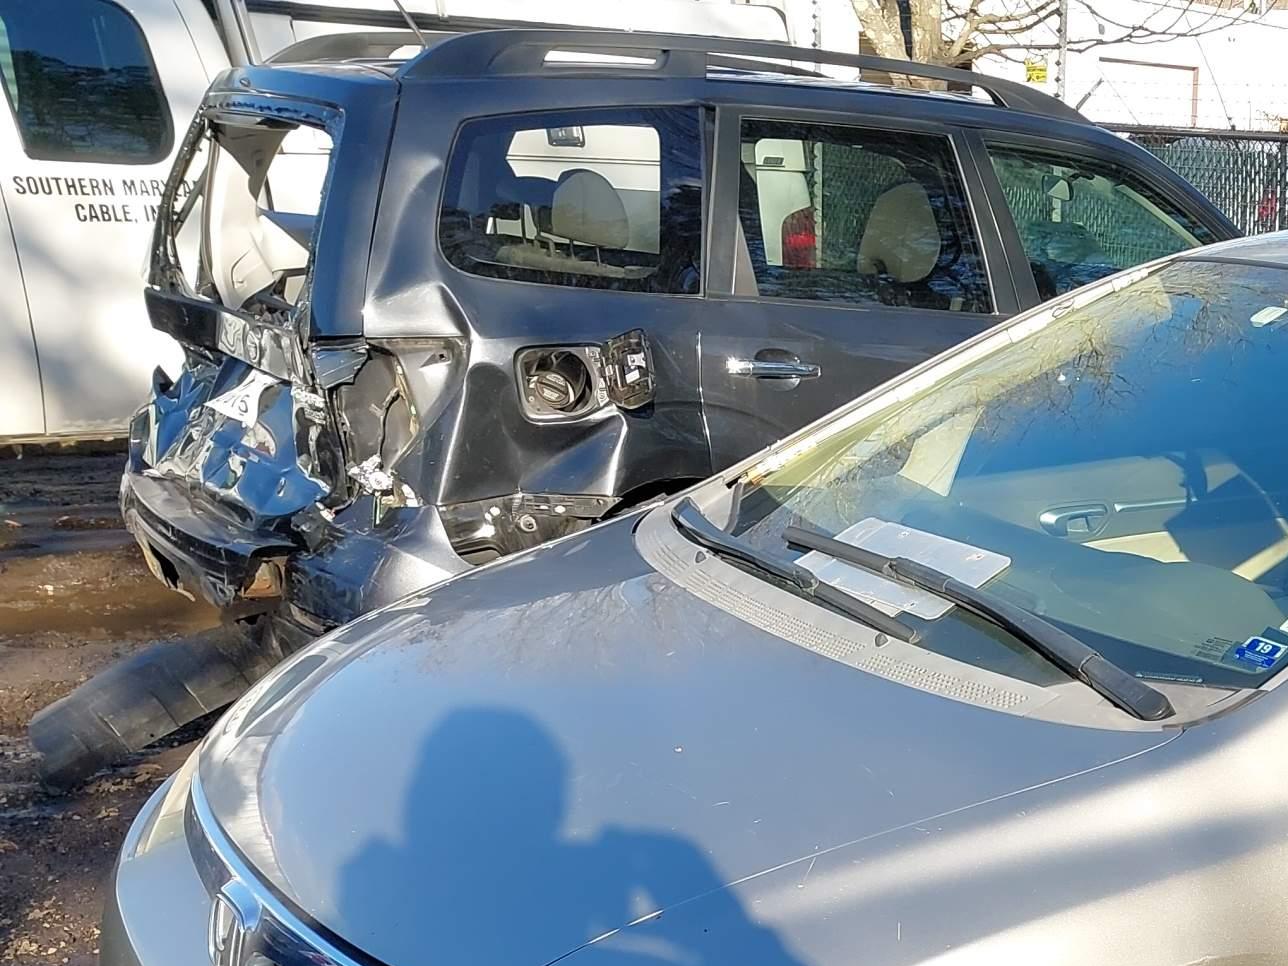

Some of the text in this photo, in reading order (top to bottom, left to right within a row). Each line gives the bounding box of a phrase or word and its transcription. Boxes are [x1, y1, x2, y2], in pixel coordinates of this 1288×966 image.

[12, 175, 198, 198] SOUTHERN MARA
[74, 203, 138, 223] CABLE,
[1255, 642, 1273, 654] 19
